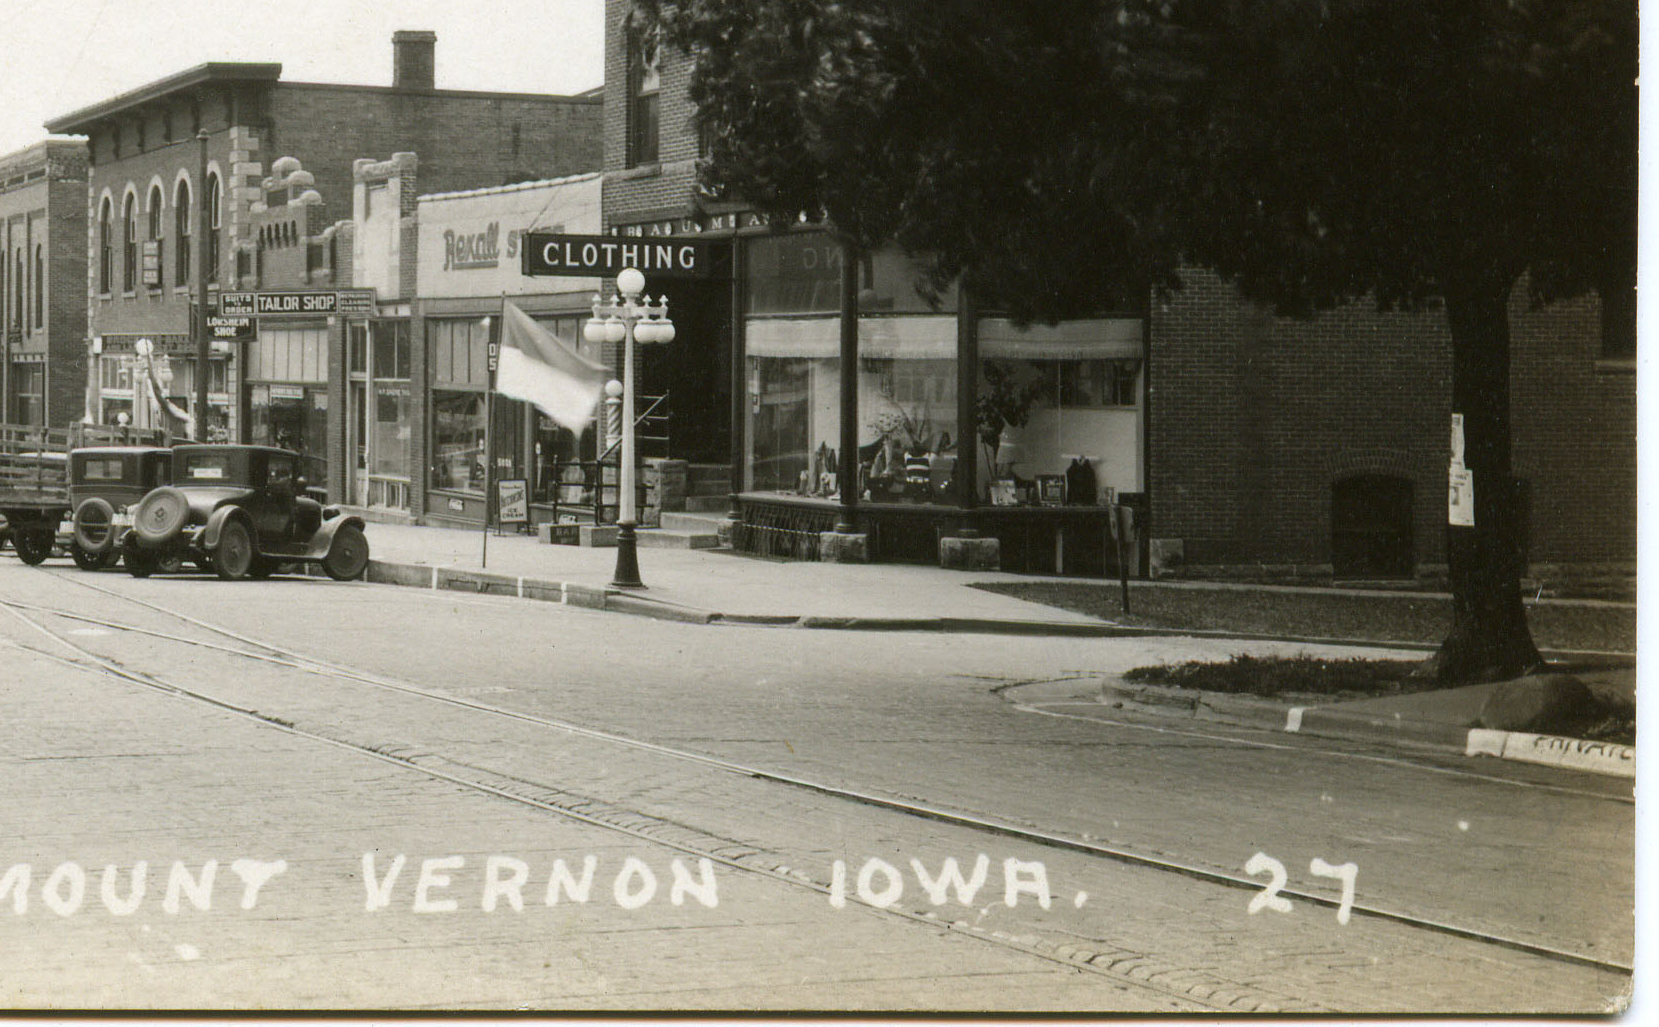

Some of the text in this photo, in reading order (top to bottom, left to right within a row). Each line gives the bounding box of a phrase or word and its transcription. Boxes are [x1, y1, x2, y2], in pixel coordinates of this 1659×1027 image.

[443, 222, 500, 271] Rexall
[543, 242, 695, 269] CLOTHING
[259, 296, 300, 311] TAILOR
[206, 316, 250, 327] LORSHEIM
[214, 327, 237, 337] SHOE
